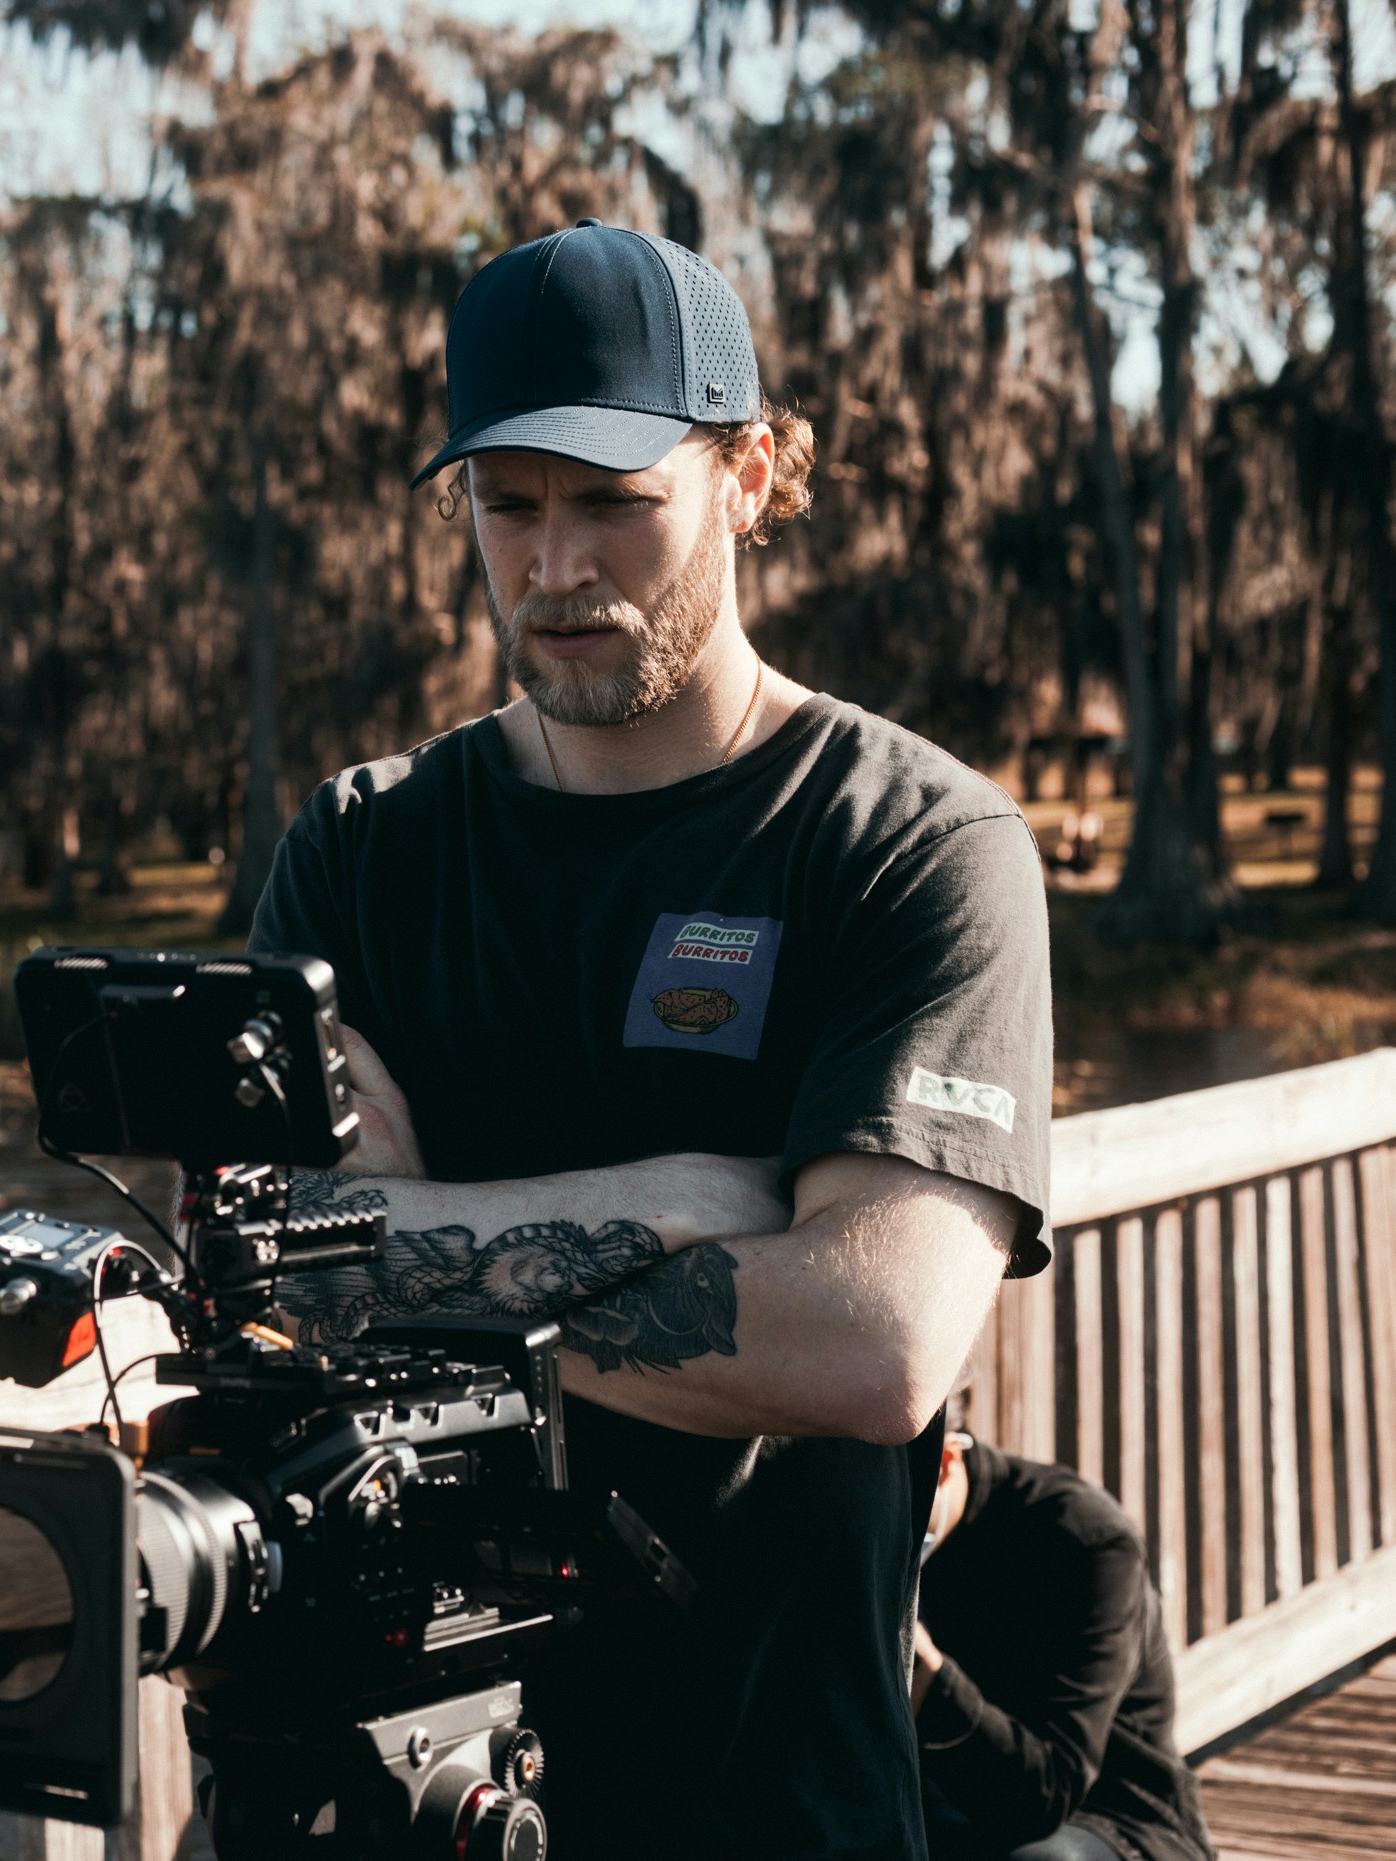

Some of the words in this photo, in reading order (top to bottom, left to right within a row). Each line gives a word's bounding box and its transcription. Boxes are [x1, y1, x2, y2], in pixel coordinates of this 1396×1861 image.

[679, 925, 756, 943] BURRITOS
[671, 944, 750, 962] BURRITOS
[918, 1075, 1012, 1127] RVCA
